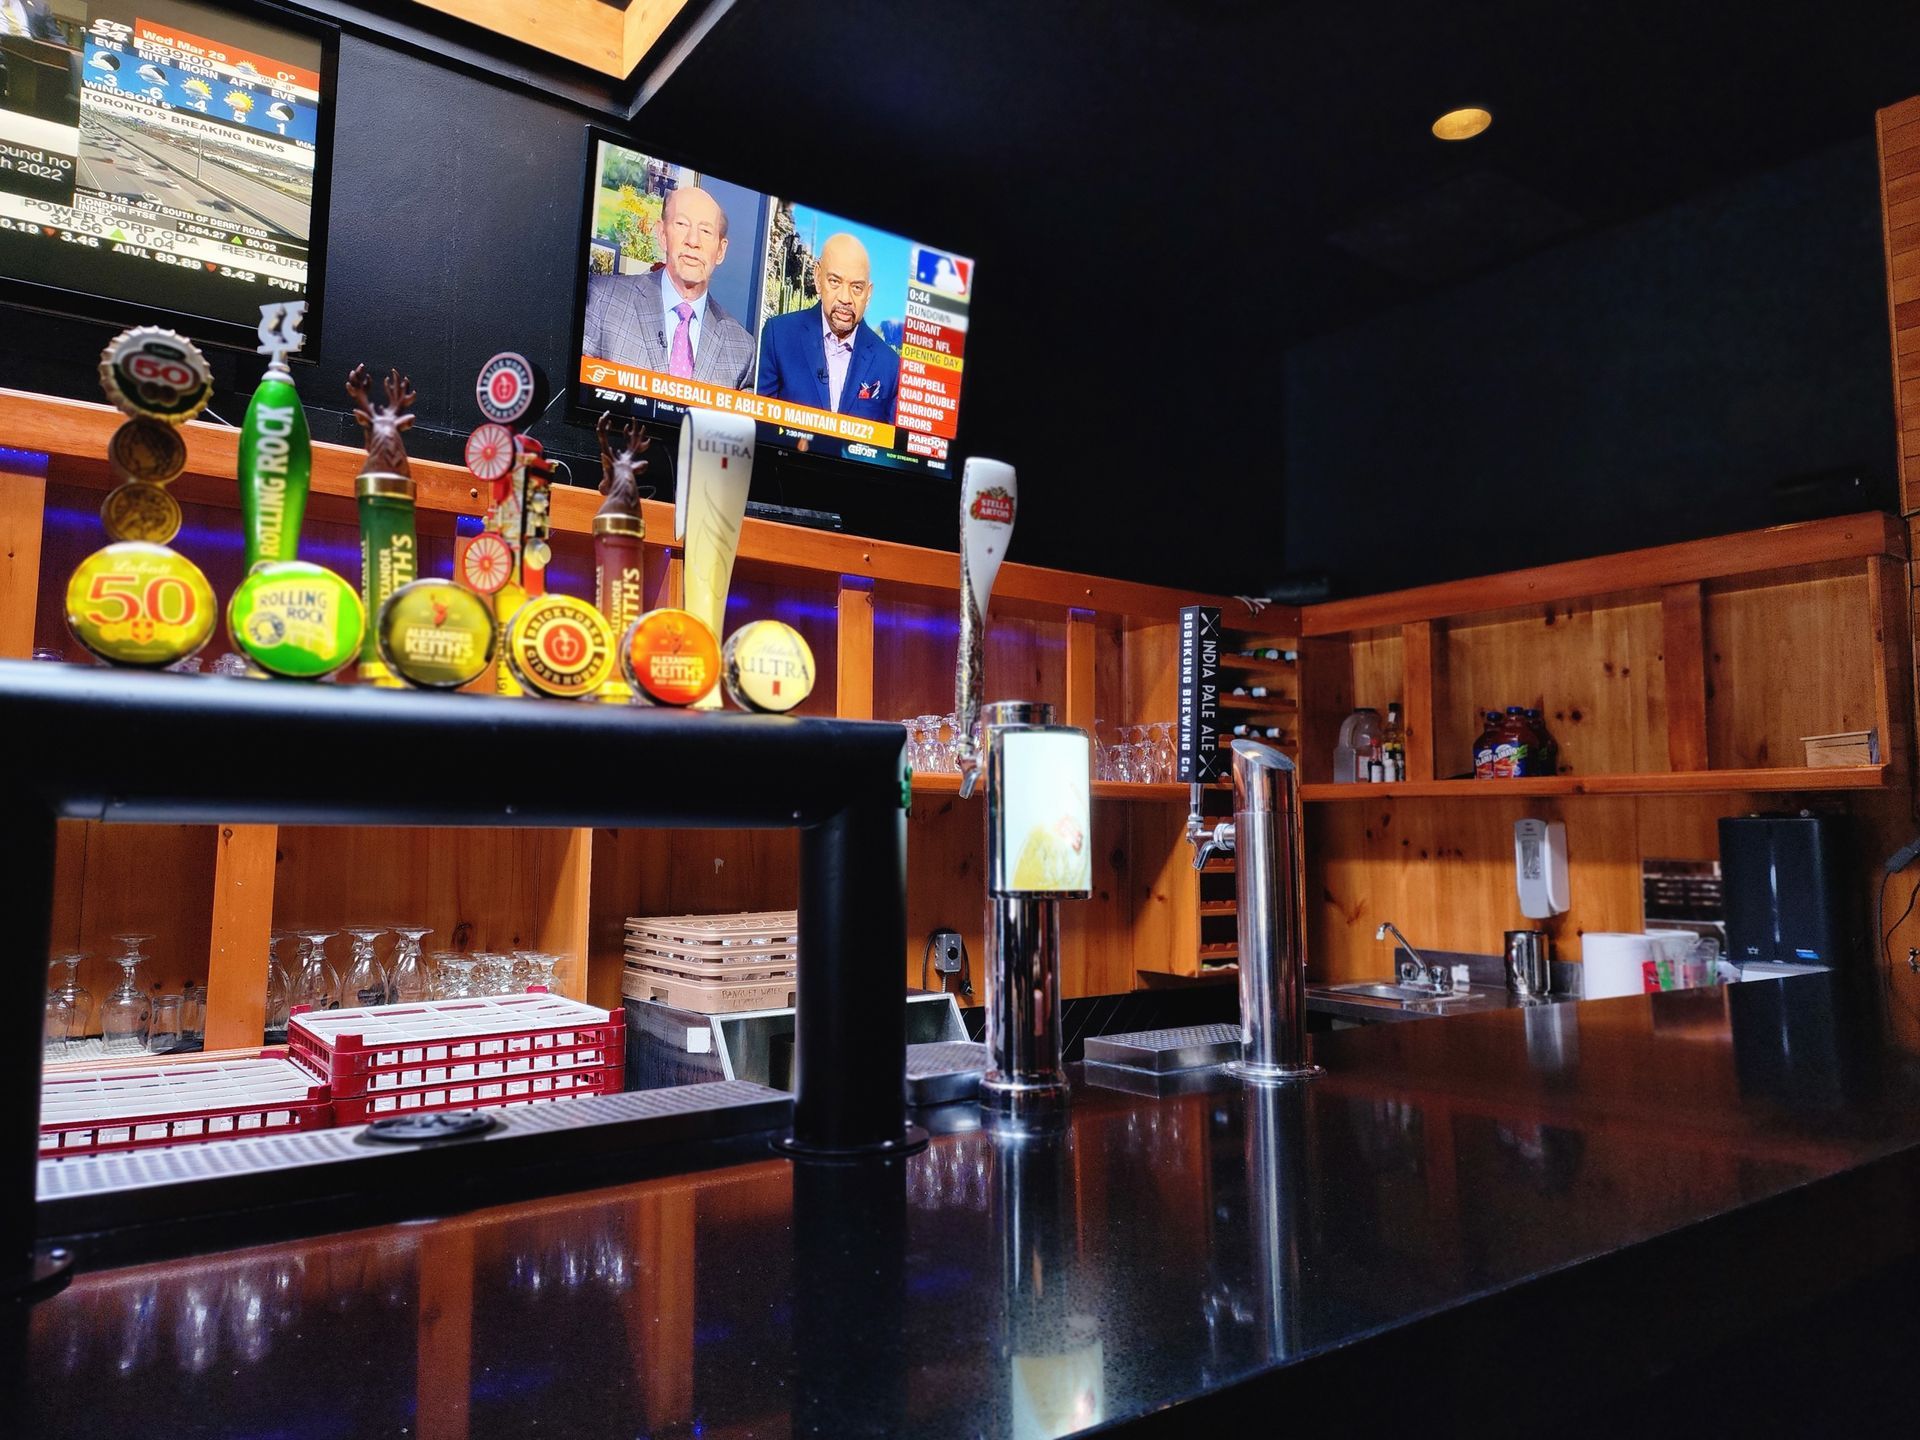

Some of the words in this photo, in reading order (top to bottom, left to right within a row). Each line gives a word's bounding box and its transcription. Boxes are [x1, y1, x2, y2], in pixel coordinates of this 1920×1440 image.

[89, 25, 128, 42] 24
[94, 18, 133, 33] CP
[95, 37, 123, 52] EVE
[142, 29, 173, 46] Wed
[177, 40, 205, 55] Mar
[207, 49, 227, 62] 29
[138, 49, 170, 66] NITE
[94, 74, 117, 87] -3
[179, 61, 219, 80] MORN
[83, 79, 158, 107] WINDSOR
[141, 86, 163, 100] -6
[229, 77, 256, 90] AFT
[185, 99, 207, 113] -4
[271, 88, 297, 103] EVE
[83, 92, 167, 120] TORONTO'S
[171, 115, 242, 141] BREAKING
[246, 136, 286, 153] NEWS
[233, 111, 247, 123] 5
[276, 122, 286, 135] 1
[18, 160, 63, 181] 2022
[48, 156, 72, 169] no
[78, 203, 113, 217] INDEX
[79, 196, 126, 214] LONDON
[128, 208, 157, 220] FTSE
[24, 199, 97, 223] POWER
[102, 216, 156, 234] CORP
[161, 230, 199, 246] CDA
[50, 213, 103, 234] 34.56
[135, 233, 175, 250] 0.04
[162, 206, 194, 220] SOUTH
[195, 213, 209, 224] OF
[210, 216, 241, 232] DERRY
[242, 224, 268, 238] ROAD
[60, 231, 100, 248] 3.46
[220, 266, 256, 282] 3.42
[267, 277, 300, 292] PVH
[909, 288, 931, 305] 0:44
[908, 304, 952, 323] RUNDOWN
[906, 318, 941, 337] DURANT
[905, 332, 934, 349] THURS
[935, 340, 951, 354] NFL
[902, 359, 926, 375] PERK
[904, 346, 941, 364] OPENING
[943, 356, 960, 368] DAY
[134, 358, 190, 385] 50
[901, 373, 947, 394] CAMPBELL
[595, 388, 627, 403] TSN
[617, 370, 648, 391] WILL
[651, 377, 713, 406] BASEBALL
[715, 392, 733, 409] BE
[734, 399, 764, 417] ABLE
[767, 402, 782, 420] TO
[784, 407, 837, 432] MAINTAIN
[839, 420, 875, 440] BUZZ?
[633, 396, 648, 406] NBA
[657, 401, 674, 412] Heat
[900, 387, 923, 402] QUAD
[924, 393, 956, 410] DOUBLE
[898, 400, 944, 421] WARRIORS
[897, 414, 933, 432] ERRORS
[255, 402, 295, 475] ROCK
[908, 431, 948, 449] PARDON
[697, 439, 752, 460] ULTRA
[847, 444, 878, 459] GHOST
[979, 507, 1010, 518] ARTOIS
[980, 499, 1010, 510] STELLA
[257, 476, 287, 557] ROLLING
[86, 573, 197, 627] 50
[259, 589, 328, 608] ROLLING
[525, 606, 603, 645] BRICKWORKS
[404, 637, 474, 658] KEITH'S
[1182, 612, 1193, 684] BOSHKUNG
[741, 655, 810, 681] ULTRA
[1202, 640, 1217, 679] INDIA
[650, 664, 706, 680] KEITH'S
[1201, 685, 1216, 718] PALE
[1181, 688, 1192, 751] BREWING
[1201, 724, 1215, 751] ALE
